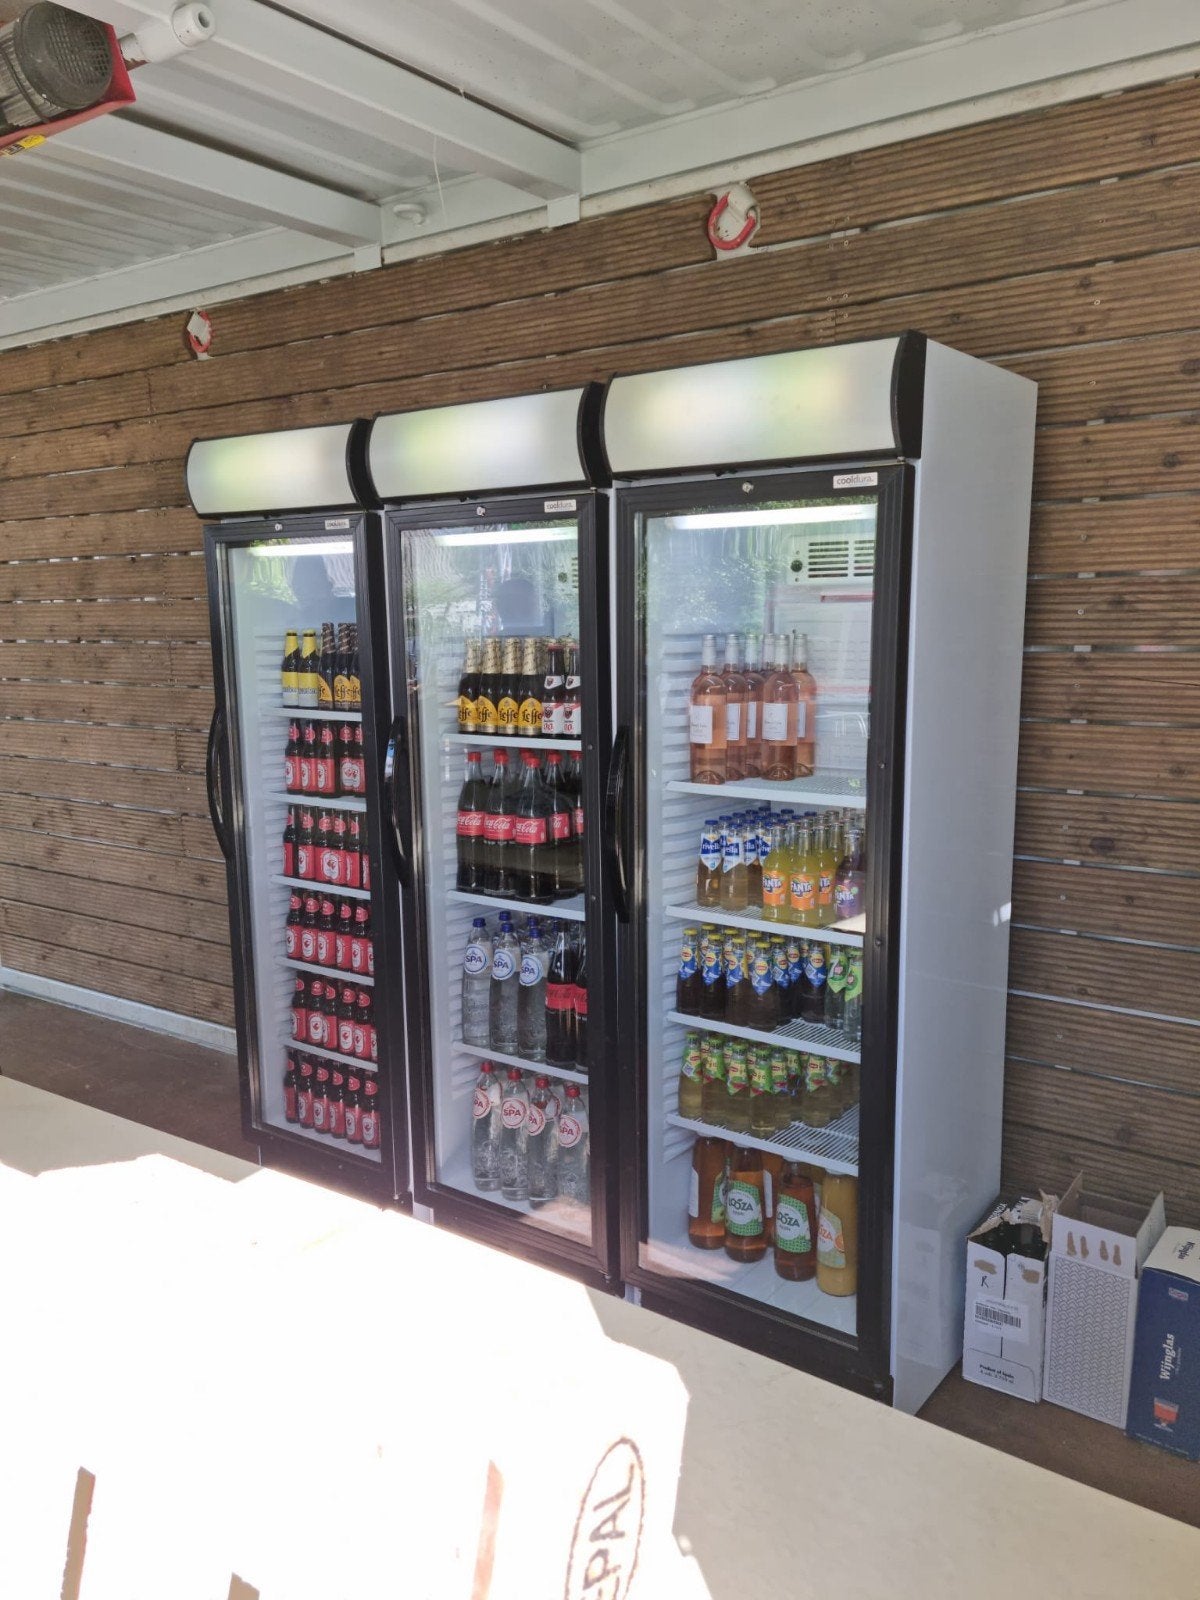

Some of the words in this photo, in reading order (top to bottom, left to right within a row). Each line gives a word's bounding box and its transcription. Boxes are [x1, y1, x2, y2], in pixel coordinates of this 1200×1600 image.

[791, 882, 812, 893] FANTA
[465, 955, 483, 964] SPA
[493, 960, 510, 970] SPA
[473, 1099, 484, 1109] PA
[503, 1108, 522, 1118] SPA
[528, 1116, 538, 1126] PA
[1159, 1333, 1176, 1380] Wijnglas
